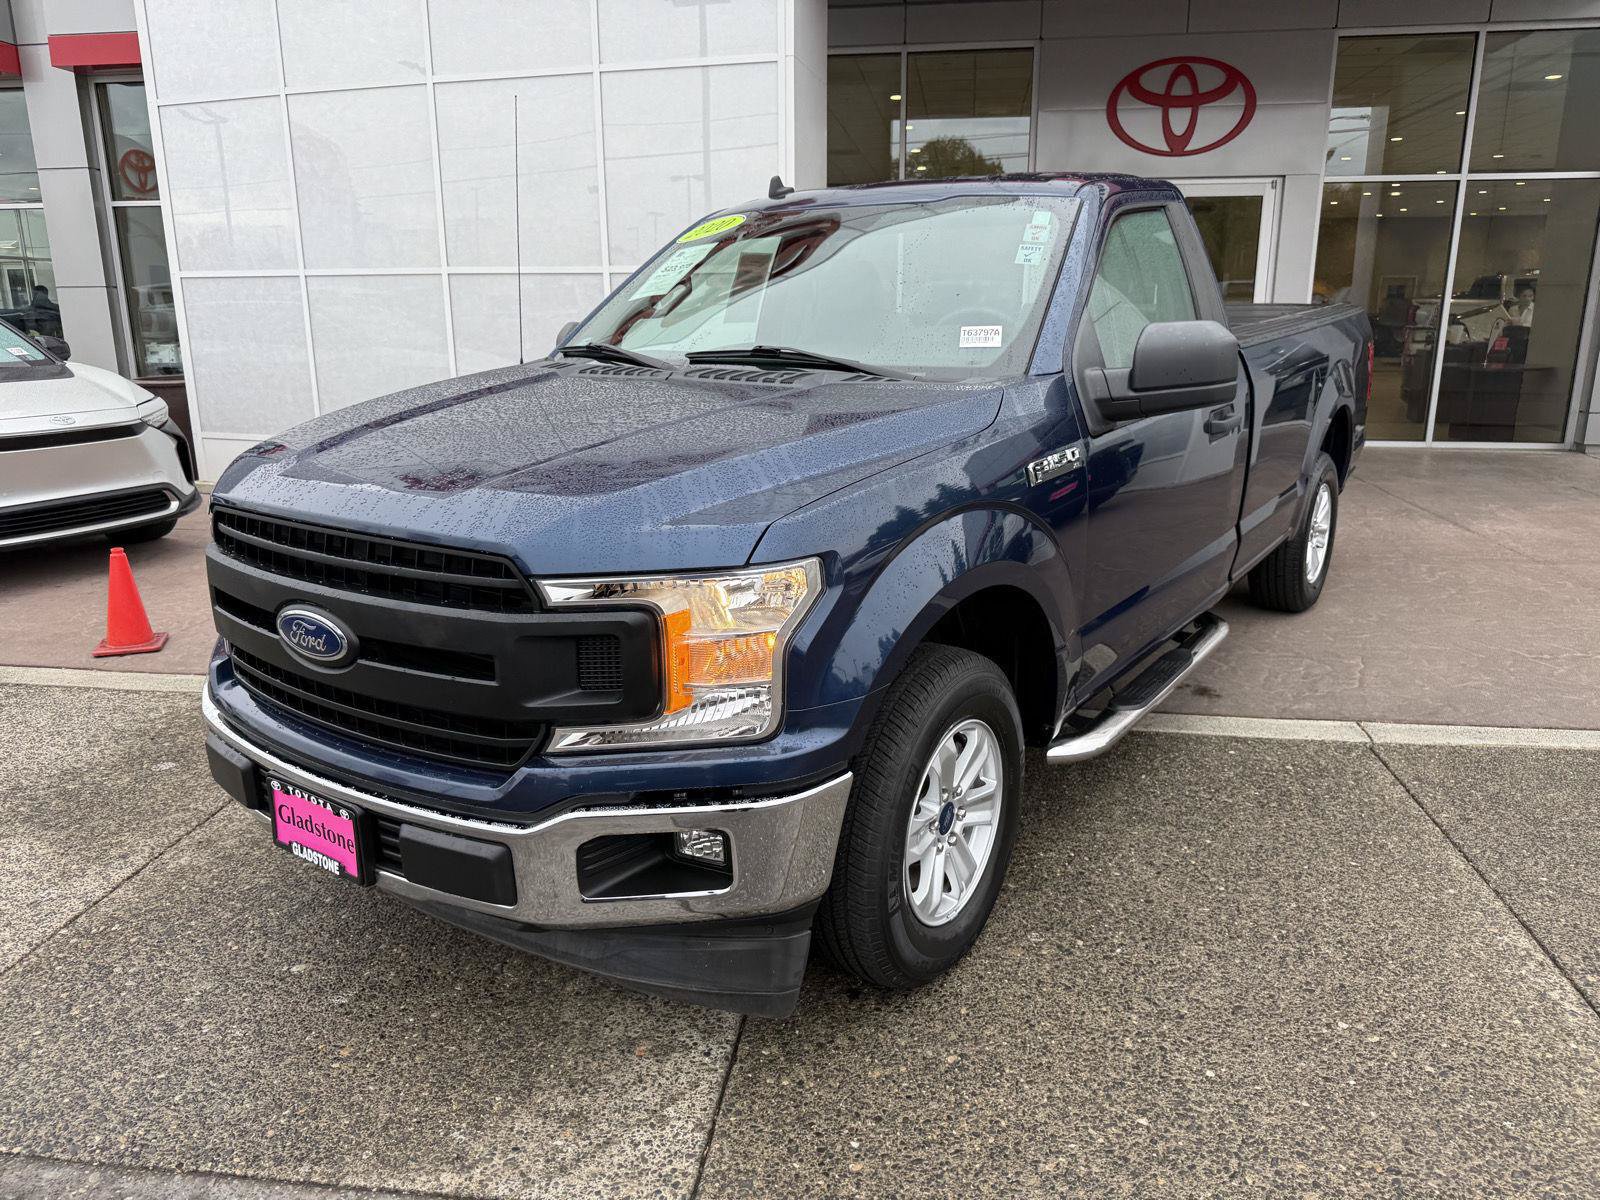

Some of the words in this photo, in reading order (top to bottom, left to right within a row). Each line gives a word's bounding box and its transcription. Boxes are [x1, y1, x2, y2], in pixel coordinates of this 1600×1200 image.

[962, 328, 1000, 337] T63797A
[289, 619, 327, 652] Ford
[287, 786, 333, 812] TOYOTA
[278, 804, 355, 854] Gladstone
[292, 842, 340, 876] GLADSTONE
